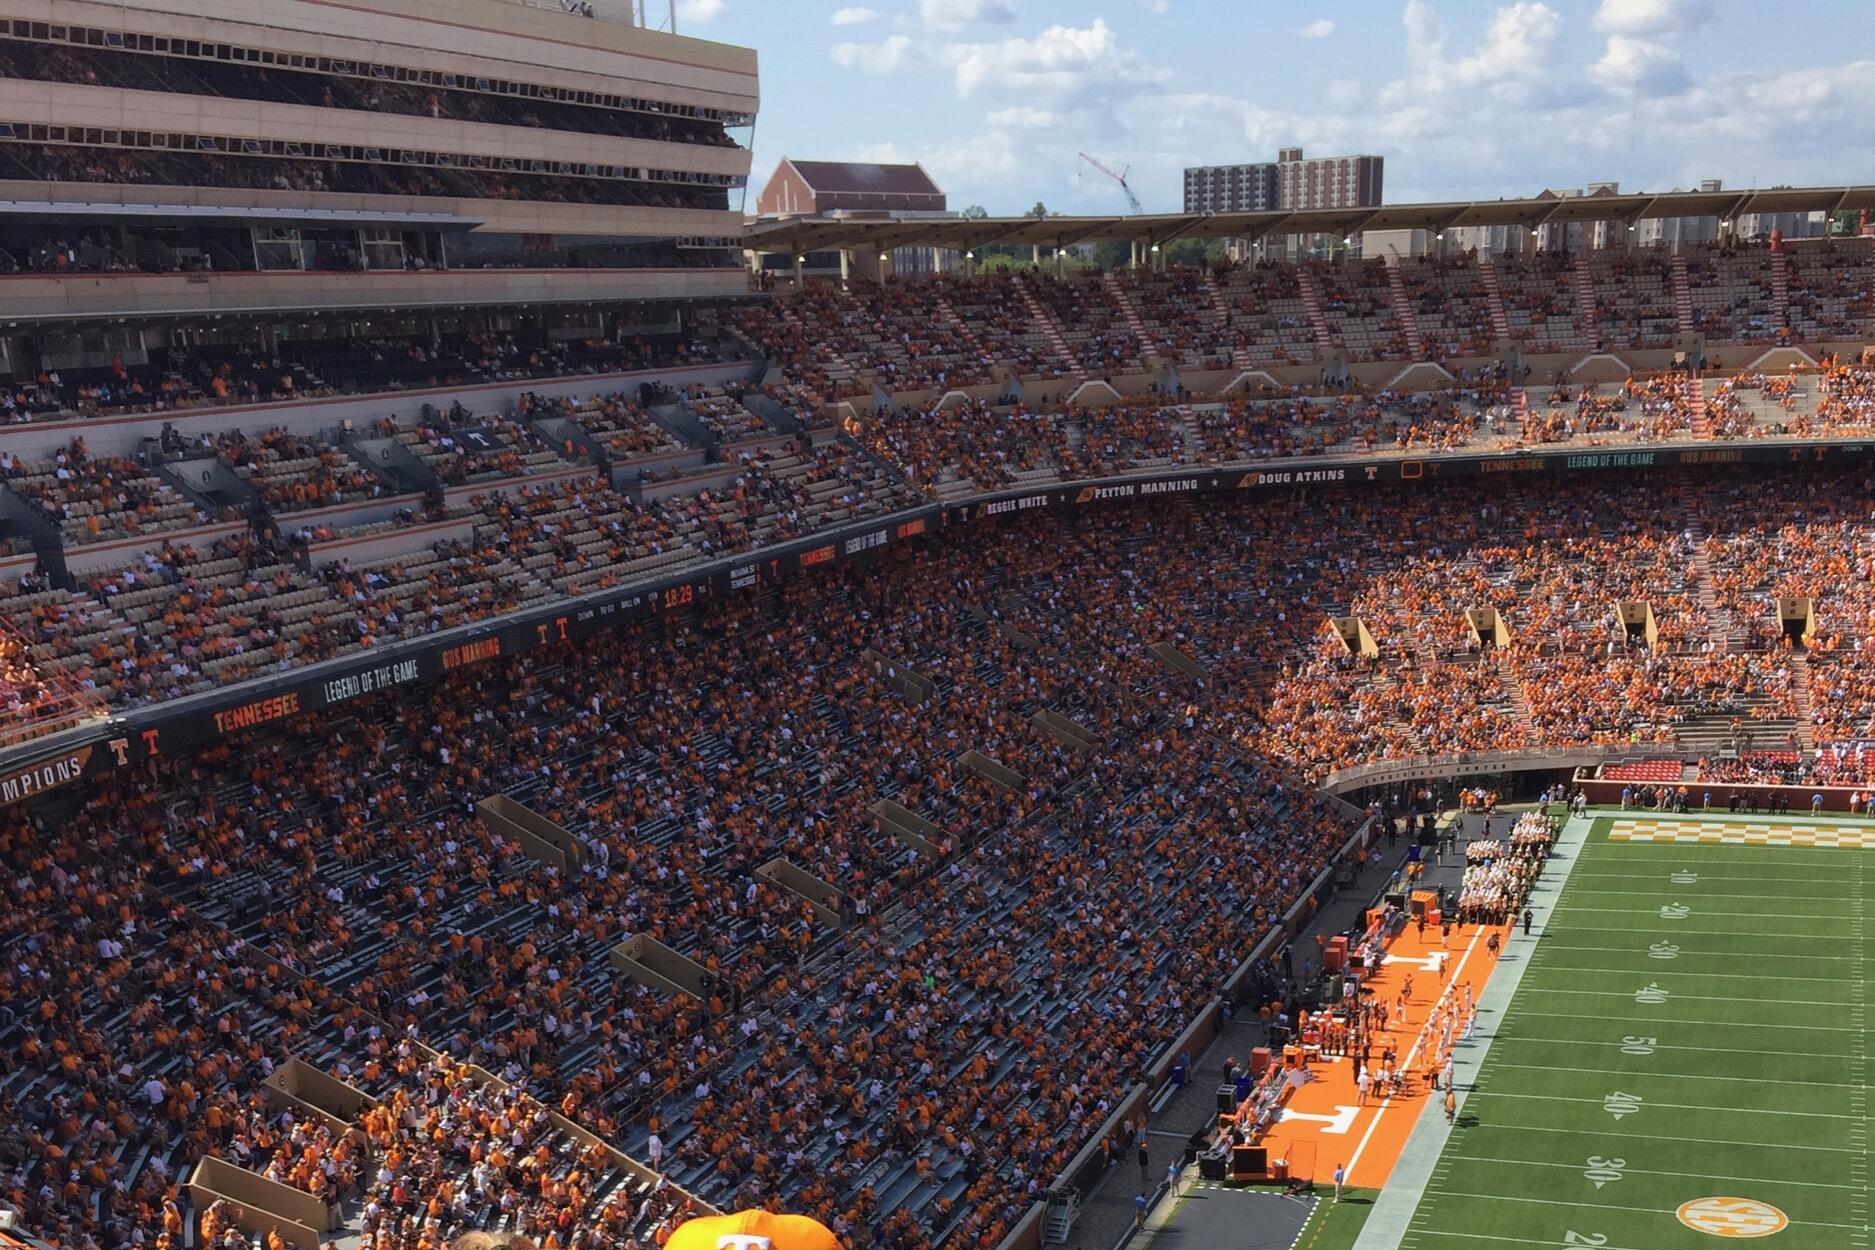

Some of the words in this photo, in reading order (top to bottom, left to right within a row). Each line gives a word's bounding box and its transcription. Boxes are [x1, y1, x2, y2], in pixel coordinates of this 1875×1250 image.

[1480, 459, 1546, 473] TENNESSEE
[1567, 455, 1598, 468] LEGEND
[1600, 454, 1612, 466] OF
[1613, 454, 1629, 466] THE
[1630, 453, 1655, 465] GAME
[1258, 472, 1291, 484] DOUG
[1296, 469, 1345, 482] ATKINS
[1094, 485, 1134, 499] PEYTON
[1141, 479, 1198, 494] MANNING
[987, 500, 1016, 515] REGGIE
[1019, 495, 1048, 509] WHITE
[325, 674, 360, 703] LEGEND
[361, 671, 373, 692] OF
[374, 665, 392, 688] THE
[393, 659, 419, 683] GAME
[213, 692, 300, 733] TENNESSEE
[109, 738, 129, 766] T
[142, 729, 159, 755] T
[1, 757, 82, 801] MPIONS
[1648, 944, 1680, 959] 30
[1635, 986, 1670, 1004] 40
[1620, 1036, 1657, 1055] 50
[1603, 1091, 1642, 1113] 40
[1583, 1156, 1626, 1181] 30
